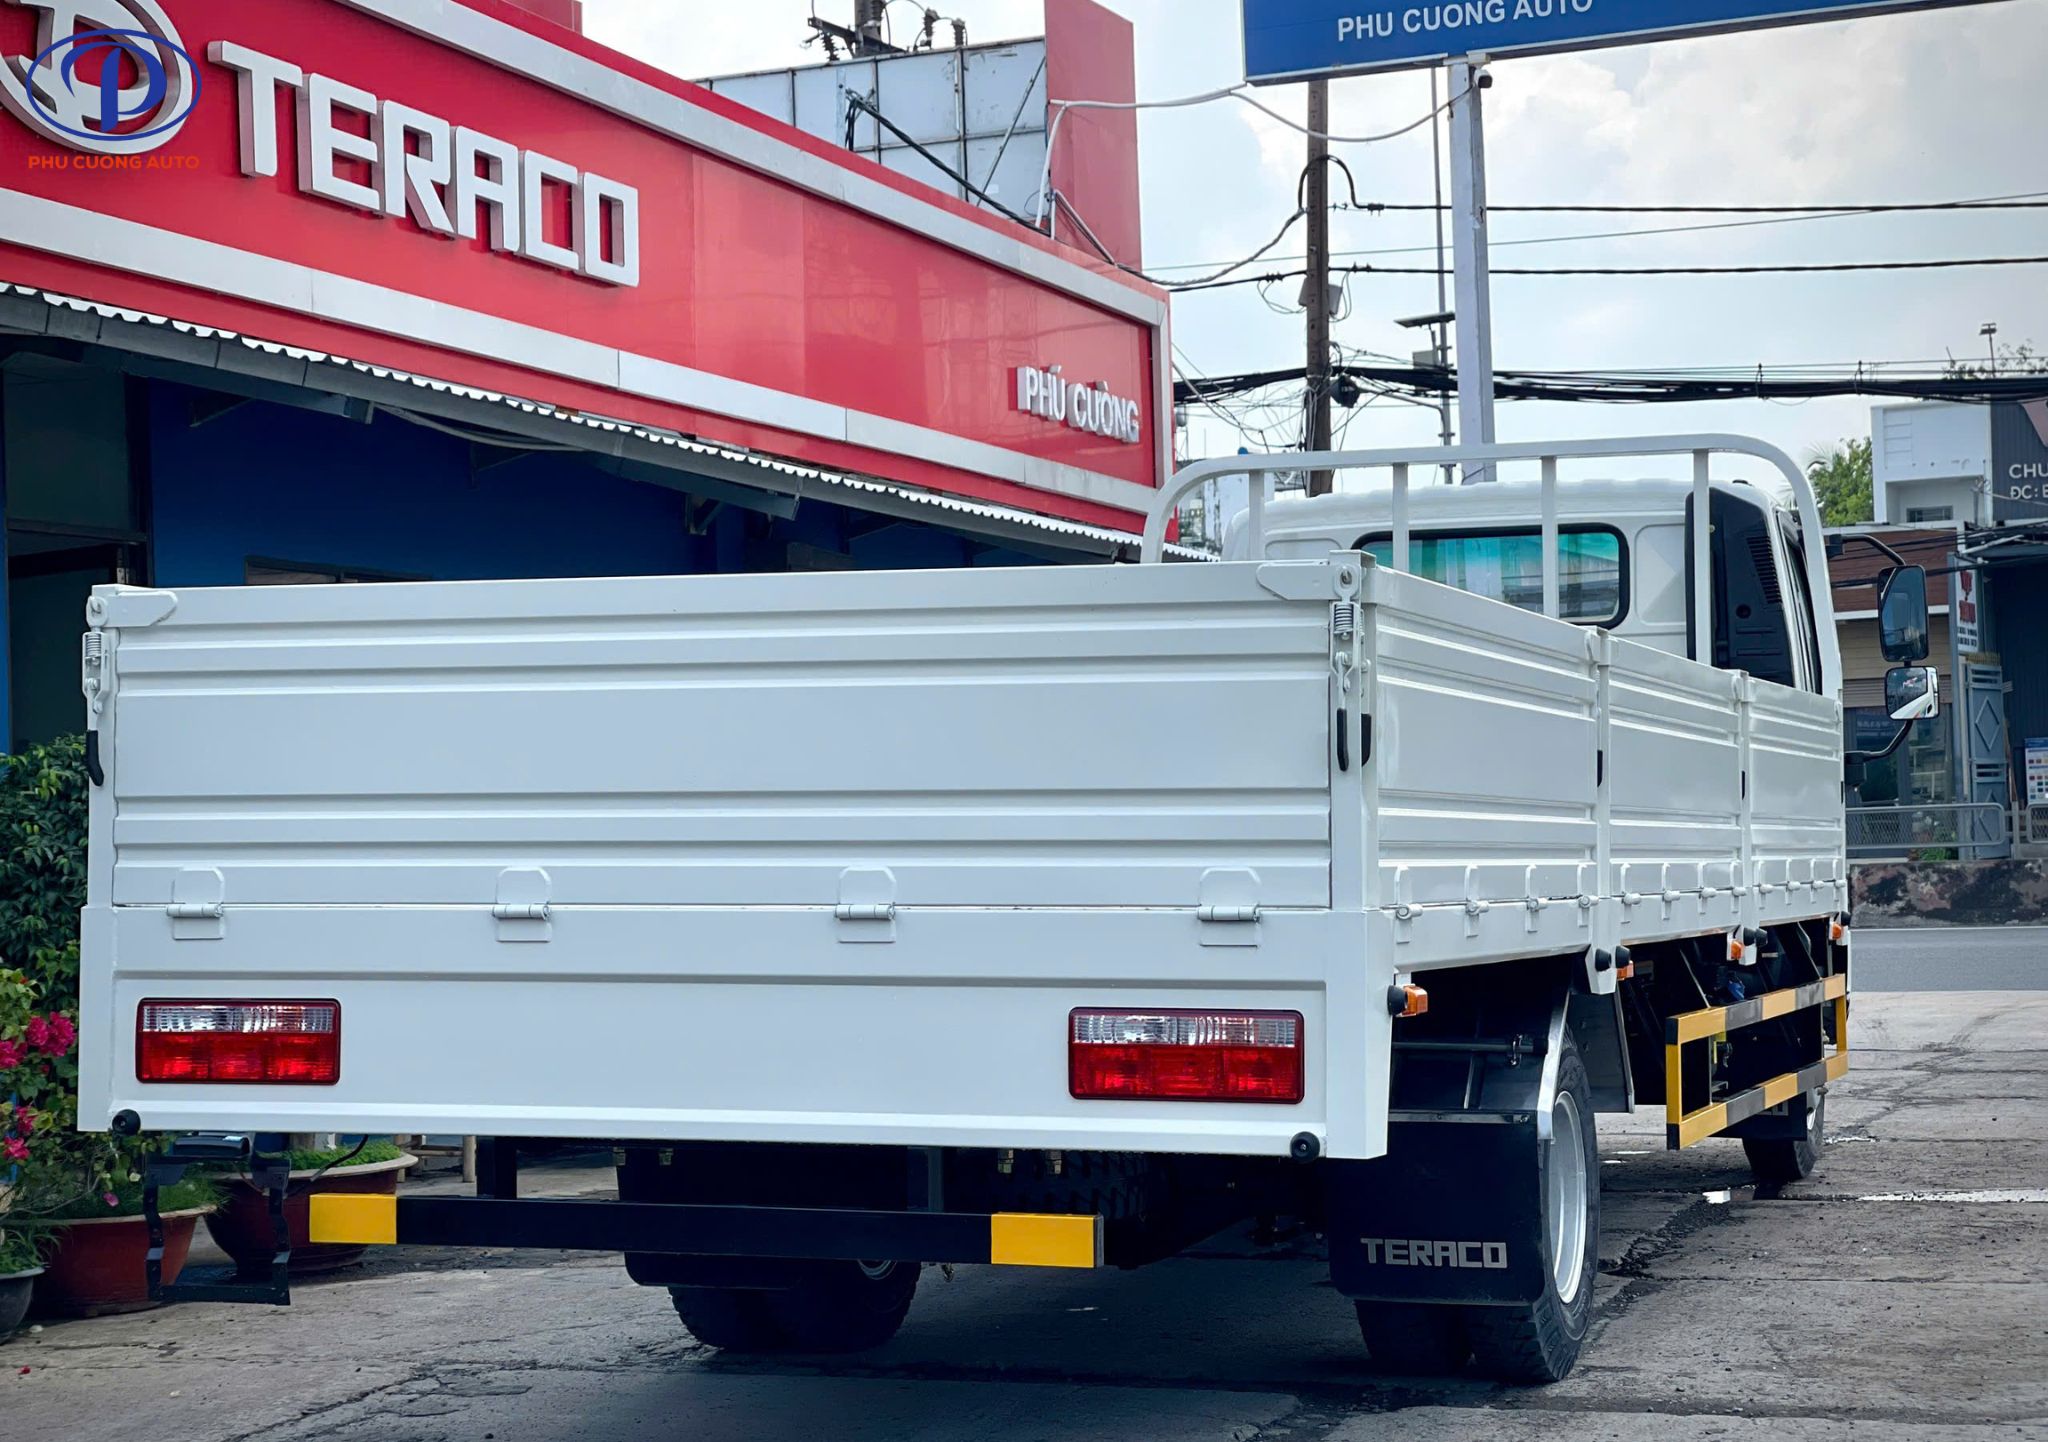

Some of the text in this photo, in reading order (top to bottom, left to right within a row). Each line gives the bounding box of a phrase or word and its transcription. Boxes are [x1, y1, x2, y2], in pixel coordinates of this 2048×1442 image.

[1337, 12, 1394, 42] PHU
[1402, 0, 1505, 33] CUONG
[207, 40, 639, 287] TERACO
[1020, 364, 1140, 443] PHÚ CƯỜNG
[1360, 1237, 1508, 1269] TERACO
